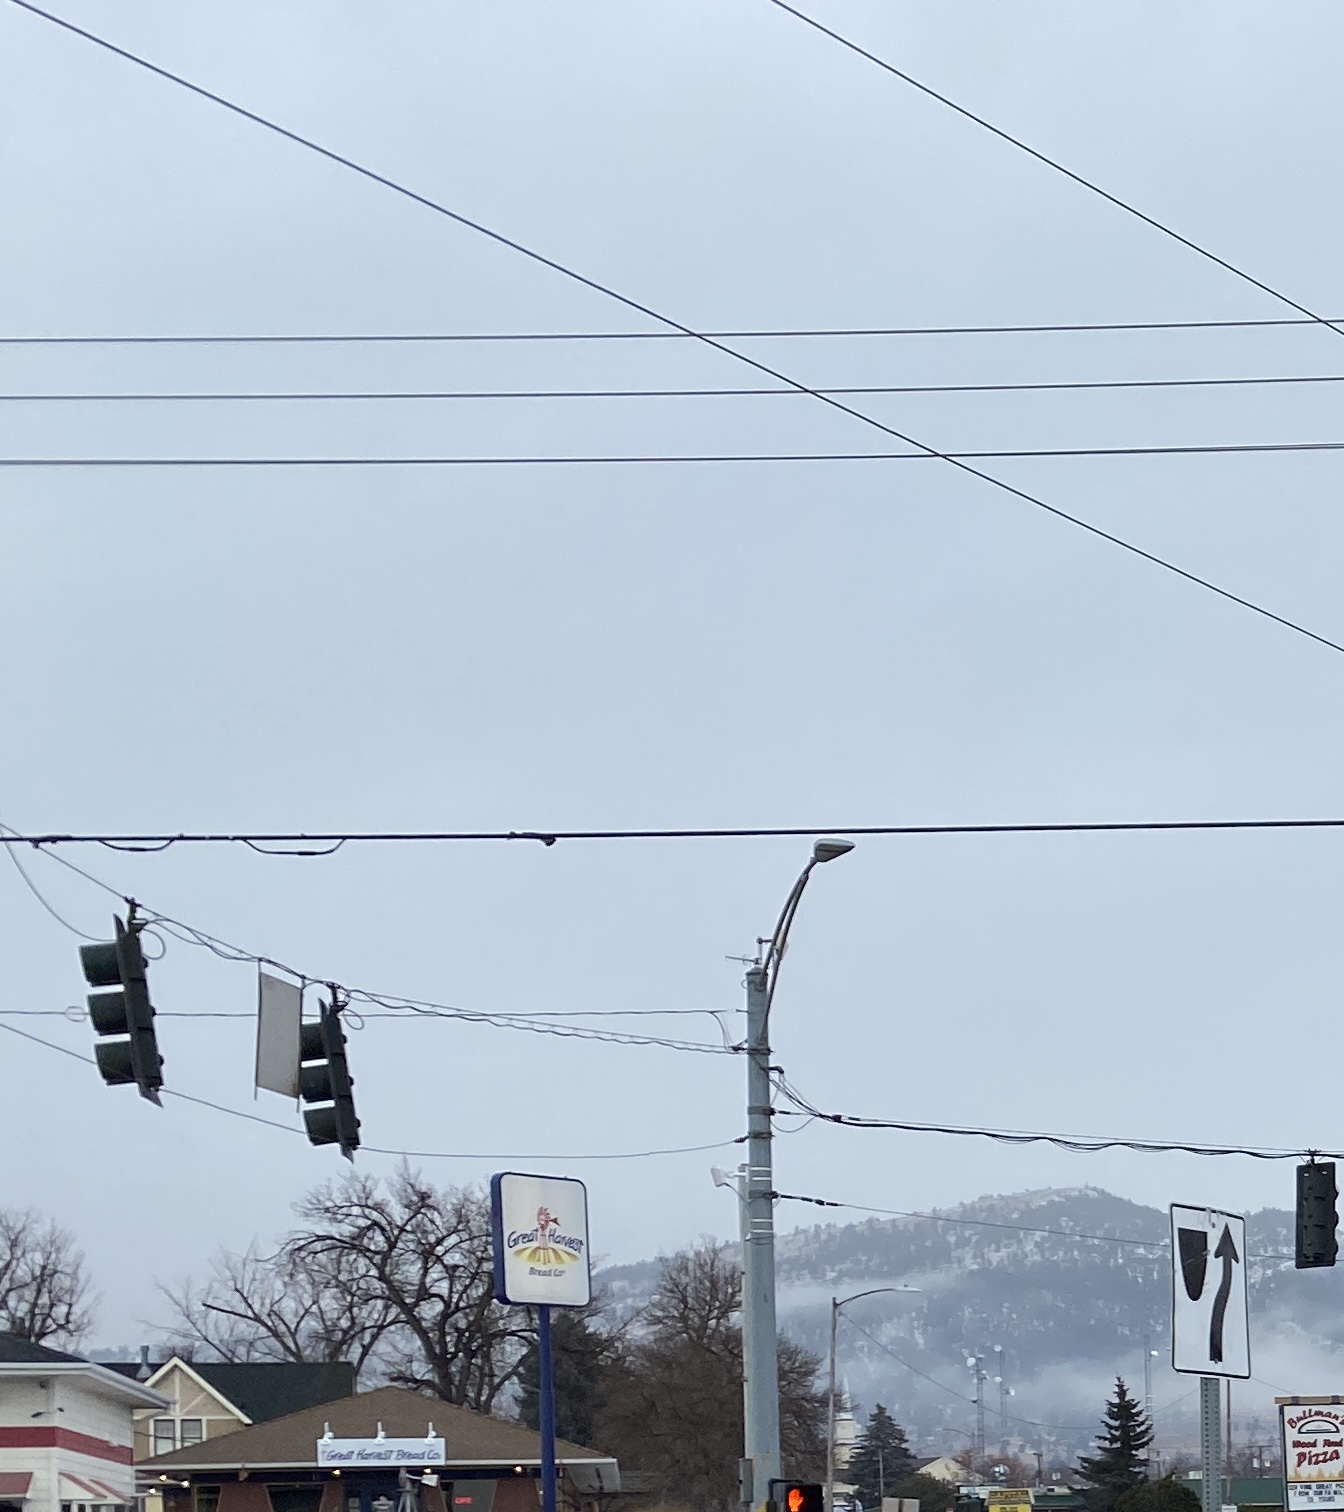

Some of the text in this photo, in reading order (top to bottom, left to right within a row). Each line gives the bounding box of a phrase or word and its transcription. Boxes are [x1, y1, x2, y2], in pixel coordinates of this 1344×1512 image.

[507, 1228, 585, 1254] Great Harvest
[528, 1266, 552, 1277] Bread
[395, 1449, 425, 1461] Bread
